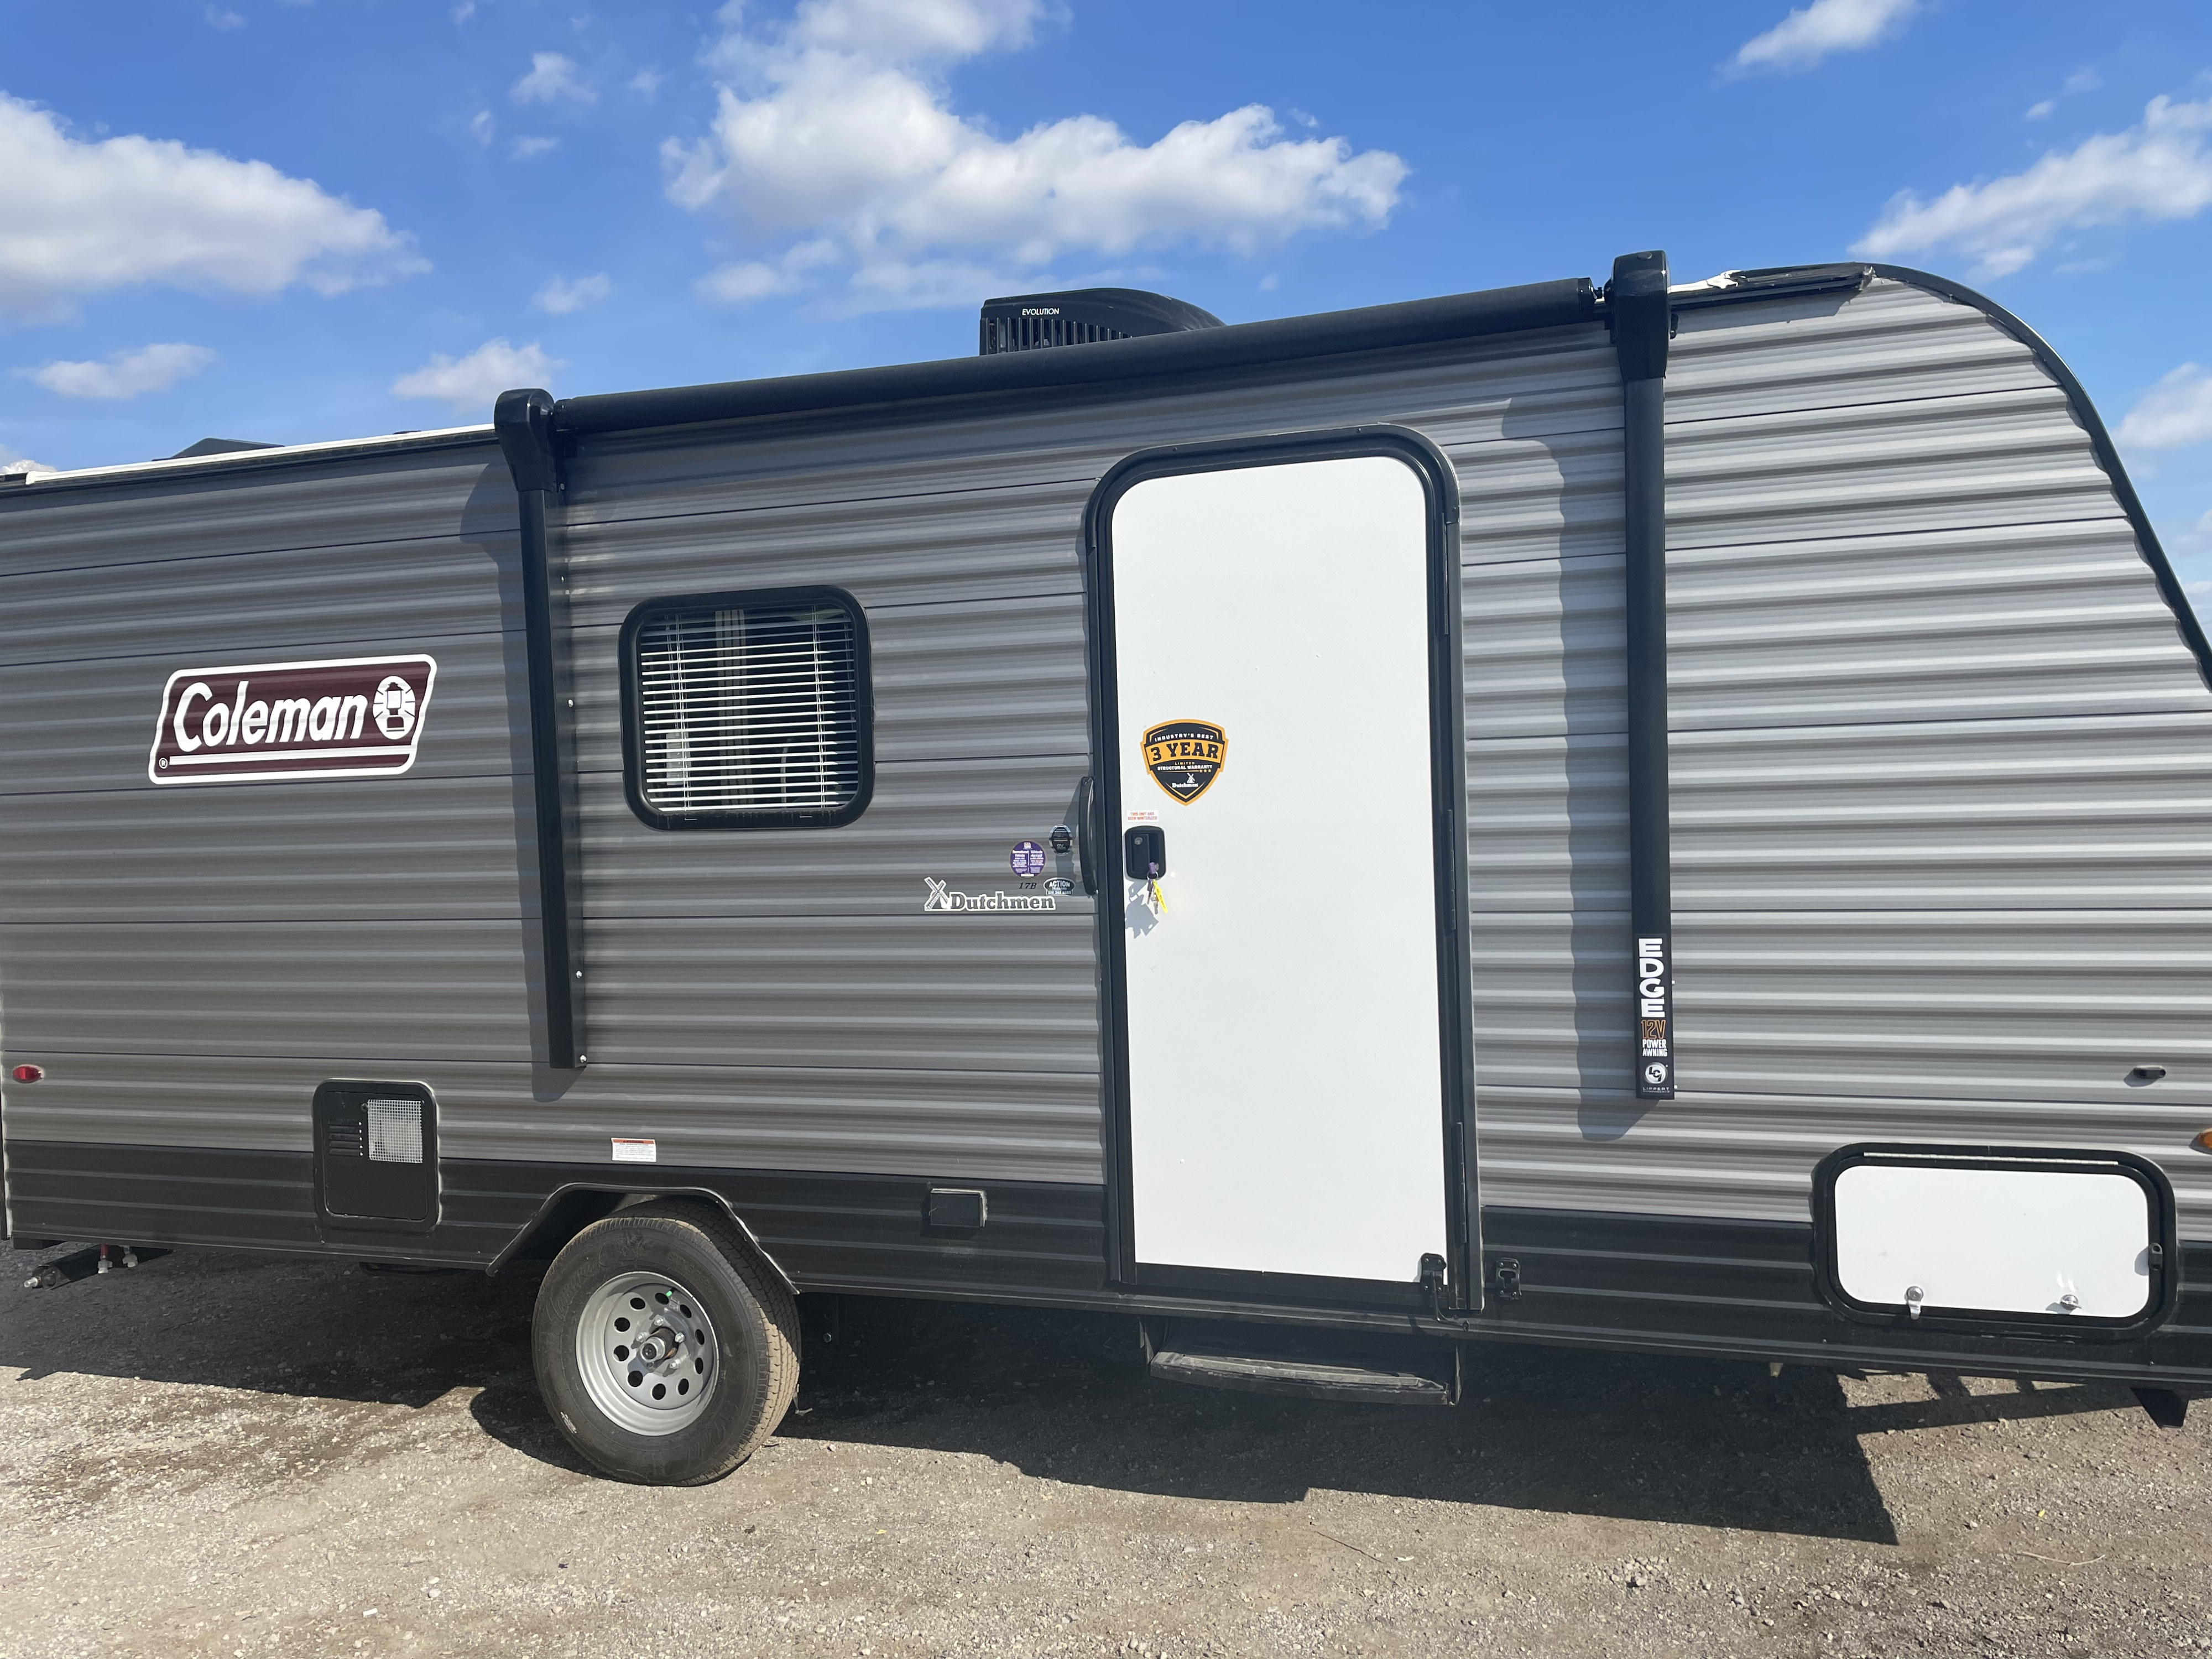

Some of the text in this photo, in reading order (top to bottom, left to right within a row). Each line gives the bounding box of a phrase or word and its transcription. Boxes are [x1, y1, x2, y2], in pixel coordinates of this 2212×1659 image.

[173, 681, 368, 752] Coleman
[1154, 733, 1194, 742] INDUSTRY'S
[1150, 742, 1218, 761] 3 YEAR
[950, 893, 1055, 910] Dutchmen
[1639, 938, 1665, 1018] EDGE
[1641, 1019, 1666, 1039] 12V
[1642, 1039, 1667, 1048] POWER
[1642, 1048, 1668, 1057] AWNING
